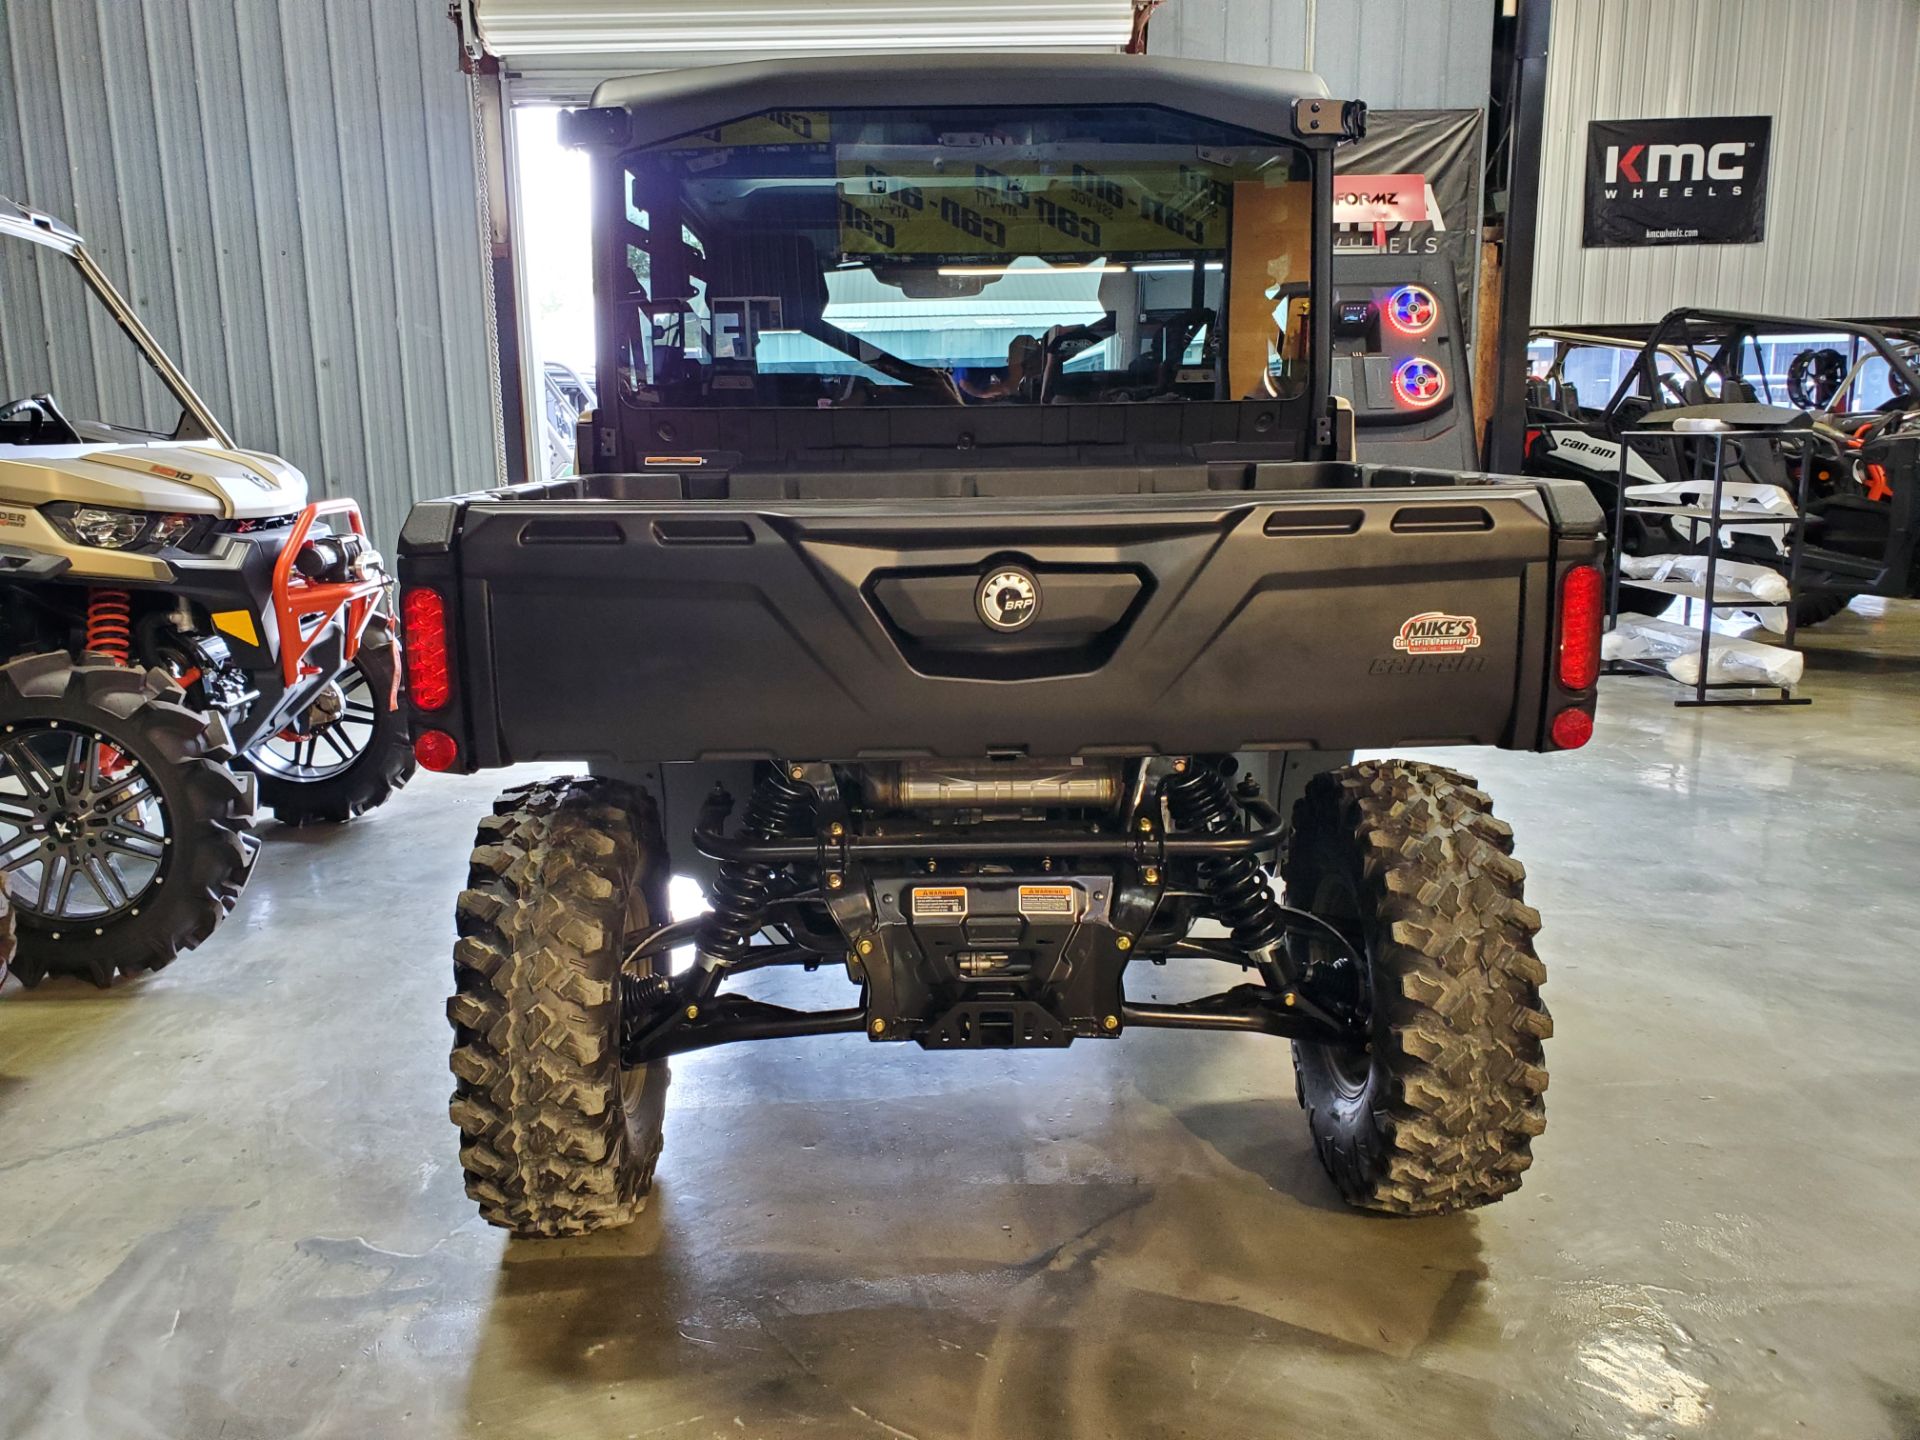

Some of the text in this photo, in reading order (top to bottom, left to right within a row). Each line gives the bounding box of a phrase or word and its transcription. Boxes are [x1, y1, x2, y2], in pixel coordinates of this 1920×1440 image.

[1605, 186, 1742, 199] WHEELS
[1645, 229, 1698, 239] kmcwheels.com
[1560, 437, 1616, 458] can-am
[1005, 598, 1033, 611] BRP
[1406, 620, 1472, 640] MIKE'S
